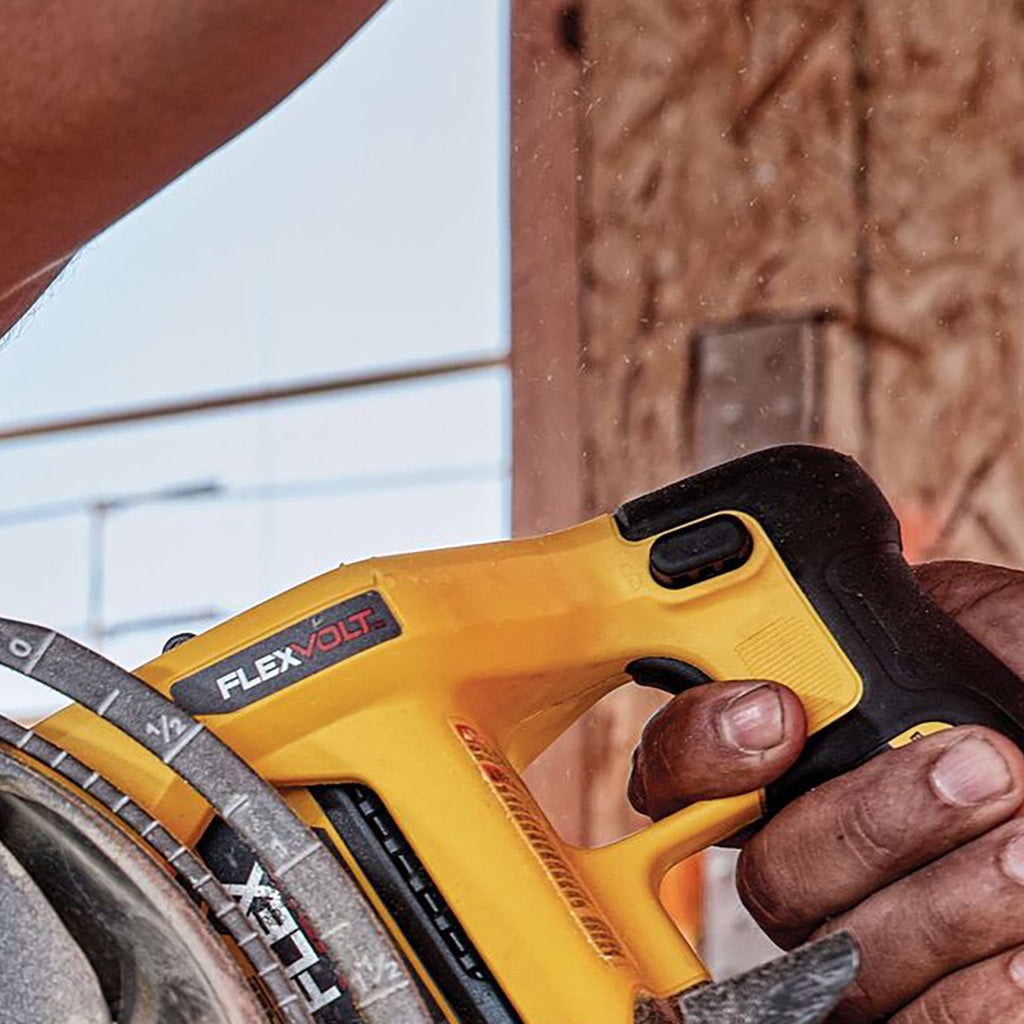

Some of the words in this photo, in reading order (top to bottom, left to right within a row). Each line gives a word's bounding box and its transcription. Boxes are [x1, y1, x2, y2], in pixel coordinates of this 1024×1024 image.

[9, 638, 32, 659] 0
[215, 608, 373, 700] FLEXVOLT
[145, 714, 188, 743] 1/2
[222, 861, 342, 1014] FLEX
